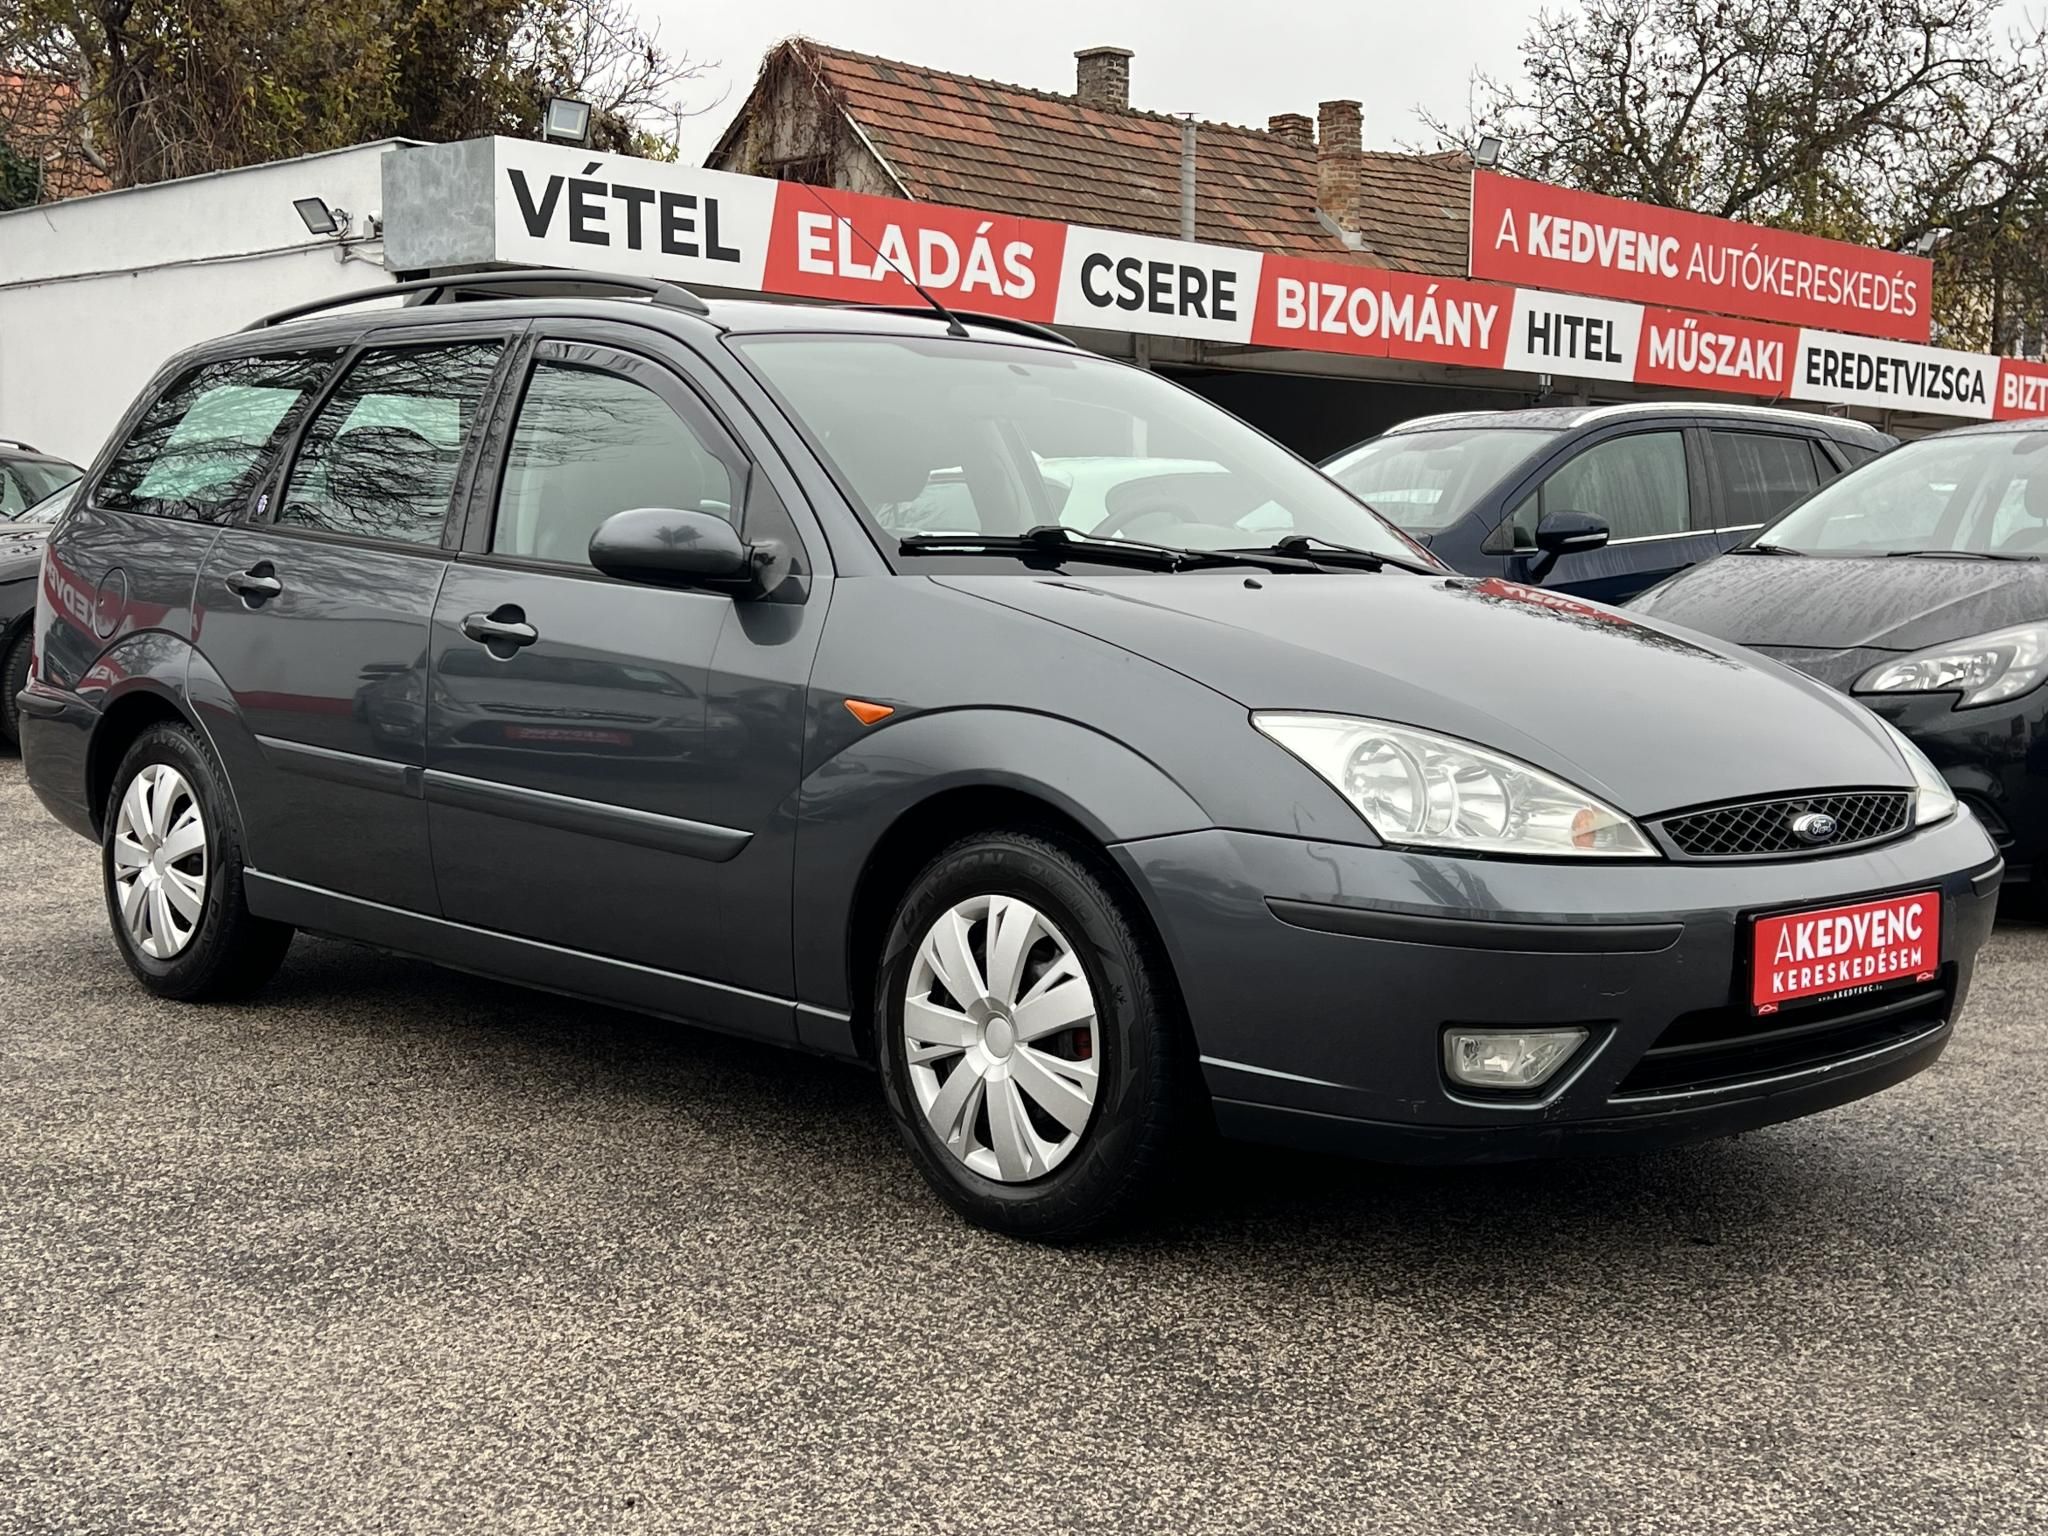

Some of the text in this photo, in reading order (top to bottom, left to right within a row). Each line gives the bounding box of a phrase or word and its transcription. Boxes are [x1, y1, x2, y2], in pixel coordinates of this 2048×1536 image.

[506, 161, 741, 263] VÉTEL
[797, 210, 1036, 300] ELADÁS
[1080, 252, 1237, 322] CSERE
[1495, 208, 1918, 318] A KEDVENC AUTÓKERESKEDÉS
[1276, 278, 1499, 350] BIZOMÁNY
[1527, 310, 1623, 364] HITEL
[1648, 318, 1784, 382] MŰSZAKI
[1806, 347, 1986, 404] EREDETVIZSGA
[1772, 945, 1922, 994] KERESKEDÉSEM
